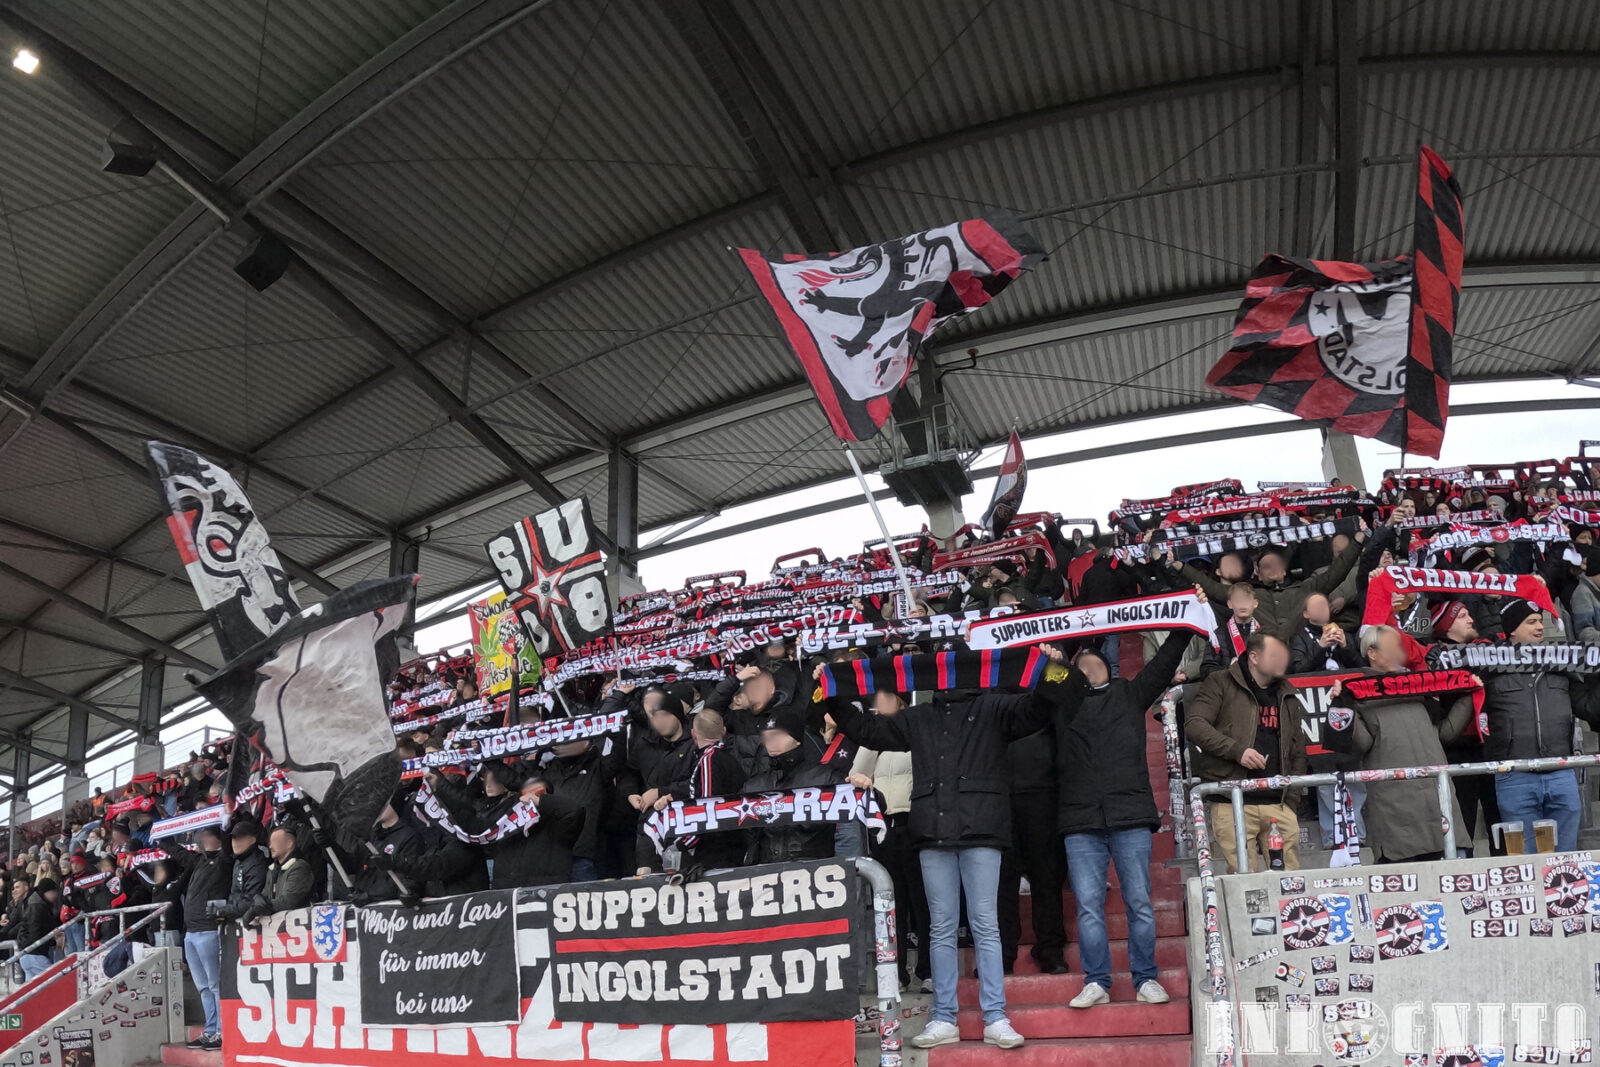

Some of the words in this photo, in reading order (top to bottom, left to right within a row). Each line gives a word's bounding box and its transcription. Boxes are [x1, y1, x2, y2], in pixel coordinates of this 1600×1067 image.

[1178, 498, 1272, 519] SCHANZER
[1400, 510, 1484, 528] CHANZER
[1386, 565, 1517, 593] SCHANZER
[726, 604, 858, 660] INGOLSTADT
[991, 615, 1071, 645] SUPPORTERS
[1107, 600, 1190, 624] INGOLSTADT
[1439, 650, 1464, 670] FC
[1466, 645, 1582, 667] INGOLSTADT
[1346, 678, 1383, 700] DIE
[480, 709, 628, 759] NGOLSTADT
[1544, 865, 1583, 888] SUPPORTERS
[552, 864, 847, 933] SUPPORTERS
[1281, 898, 1323, 921] SUPPORTERS
[1549, 895, 1588, 916] INGOLSTADT
[412, 902, 454, 931] und
[458, 897, 508, 929] Lars
[1375, 906, 1417, 930] SUPPORTERS
[241, 910, 308, 961] FKS
[1286, 926, 1328, 948] INGOLSTADT
[1381, 934, 1422, 957] INGOLSTADT
[379, 949, 411, 984] für
[415, 948, 486, 972] immer
[556, 943, 851, 1003] INGOLSTADT
[395, 991, 427, 1016] bei
[431, 993, 473, 1014] uns
